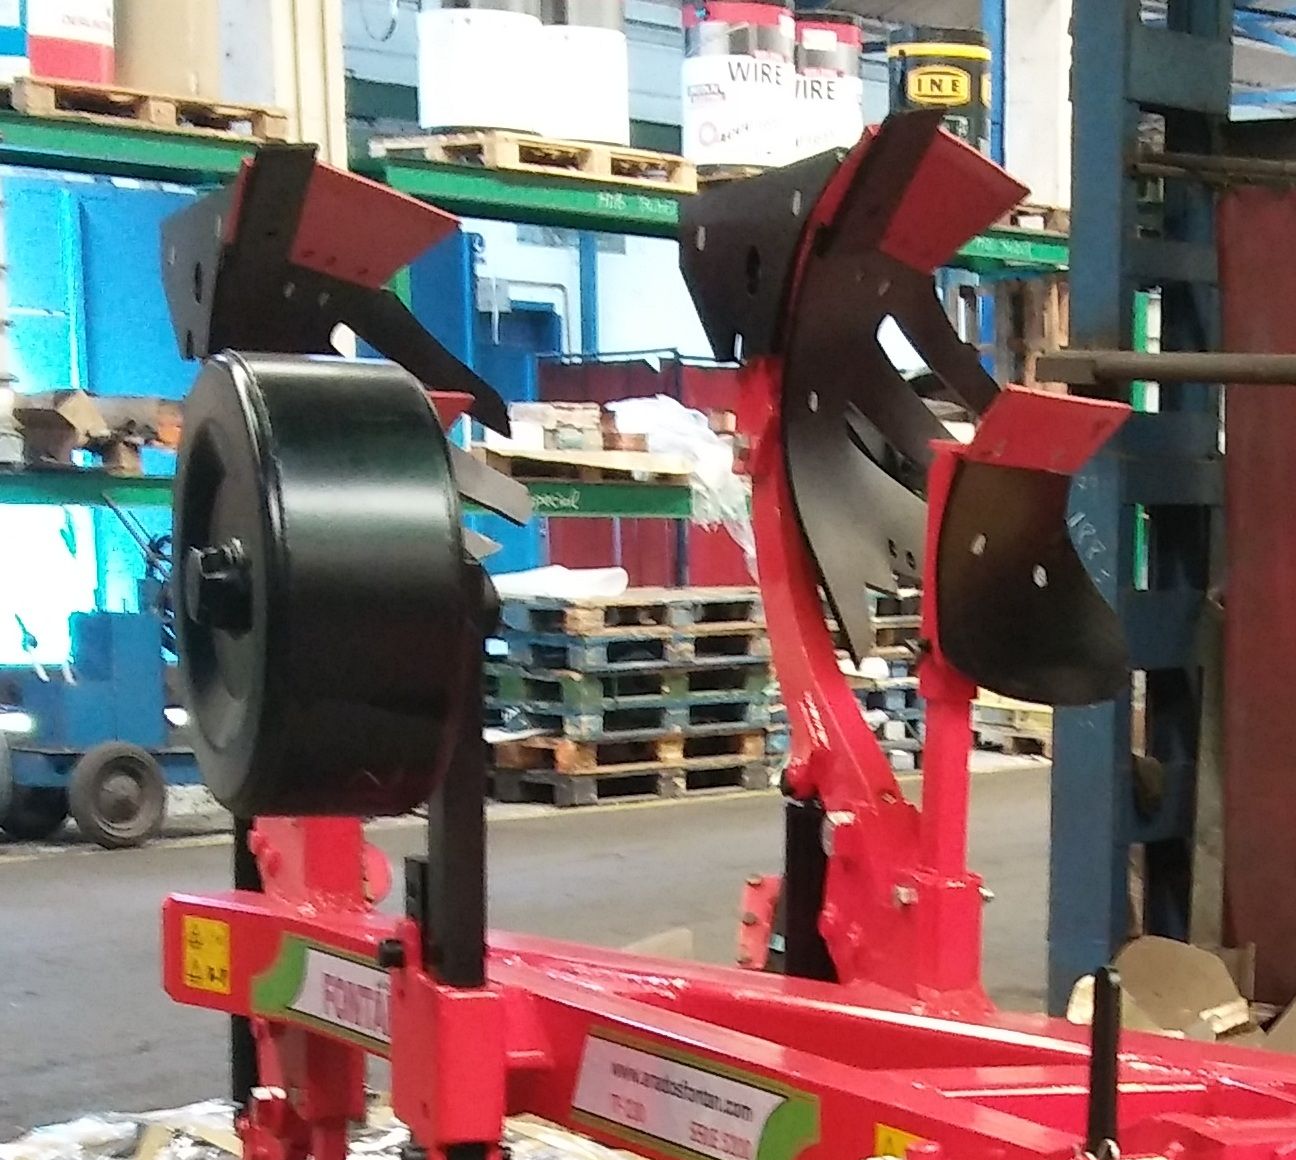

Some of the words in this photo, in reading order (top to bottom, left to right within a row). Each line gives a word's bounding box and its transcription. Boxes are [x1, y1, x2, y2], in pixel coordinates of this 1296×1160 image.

[727, 61, 782, 86] WIRE
[795, 79, 836, 101] IRE
[917, 78, 961, 93] INE
[531, 487, 581, 511] pecial
